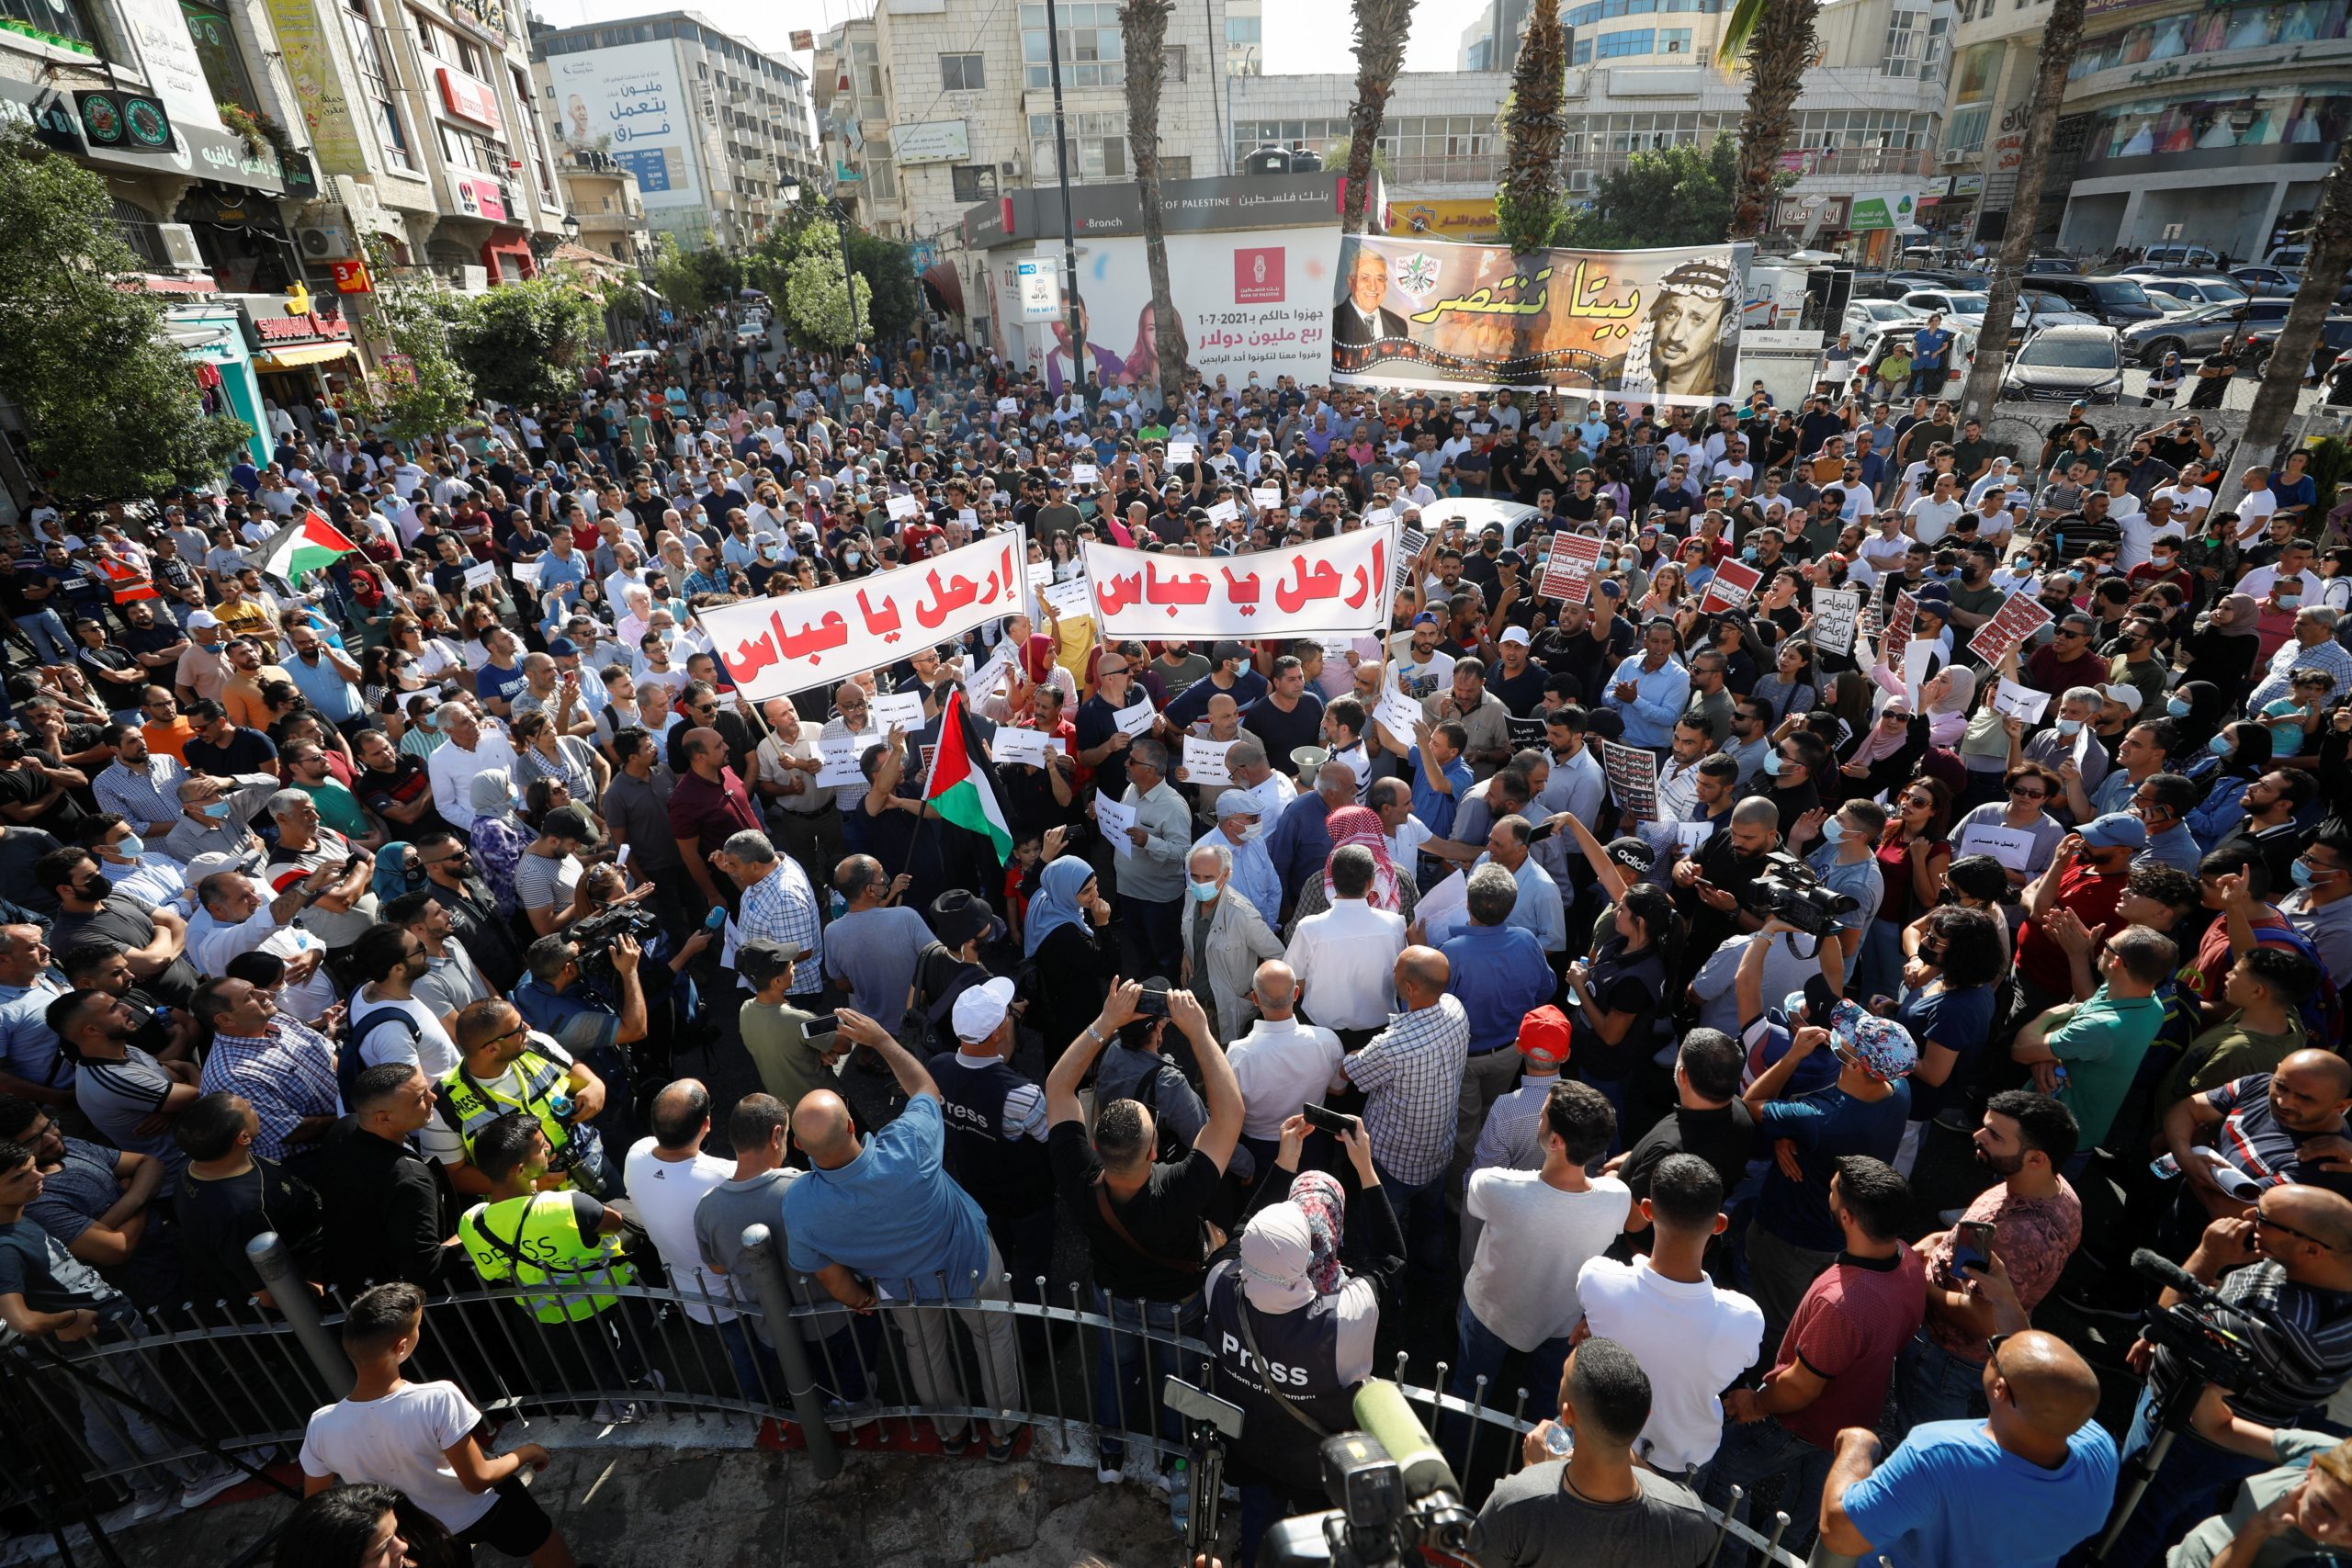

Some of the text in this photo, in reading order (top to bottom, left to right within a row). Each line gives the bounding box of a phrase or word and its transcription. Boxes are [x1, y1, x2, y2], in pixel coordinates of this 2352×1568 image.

[620, 81, 662, 98] مليون
[610, 96, 668, 120] بتعمل
[614, 119, 671, 142] فرق
[1182, 197, 1231, 209] PALESTINE
[1238, 190, 1329, 207] بنك فلسطين
[336, 265, 349, 281] 3
[1409, 258, 1641, 341] بيتا تنتصر
[1259, 310, 1290, 325] حالكم
[1294, 309, 1324, 321] جهزوا
[257, 314, 315, 340] SHAWARMA
[1199, 327, 1323, 350] ربع مليون دولار
[1199, 355, 1230, 365] الرابحين
[1248, 352, 1276, 363] لتكونوا
[1279, 352, 1296, 360] معنا
[1299, 351, 1321, 360] وفروا
[63, 578, 89, 589] PRESS
[1274, 537, 1385, 614] إرحل
[1096, 559, 1213, 618] عباس
[1220, 565, 1261, 617] يا
[721, 544, 1017, 684] إرحل يا عباس
[1252, 1382, 1262, 1392] of
